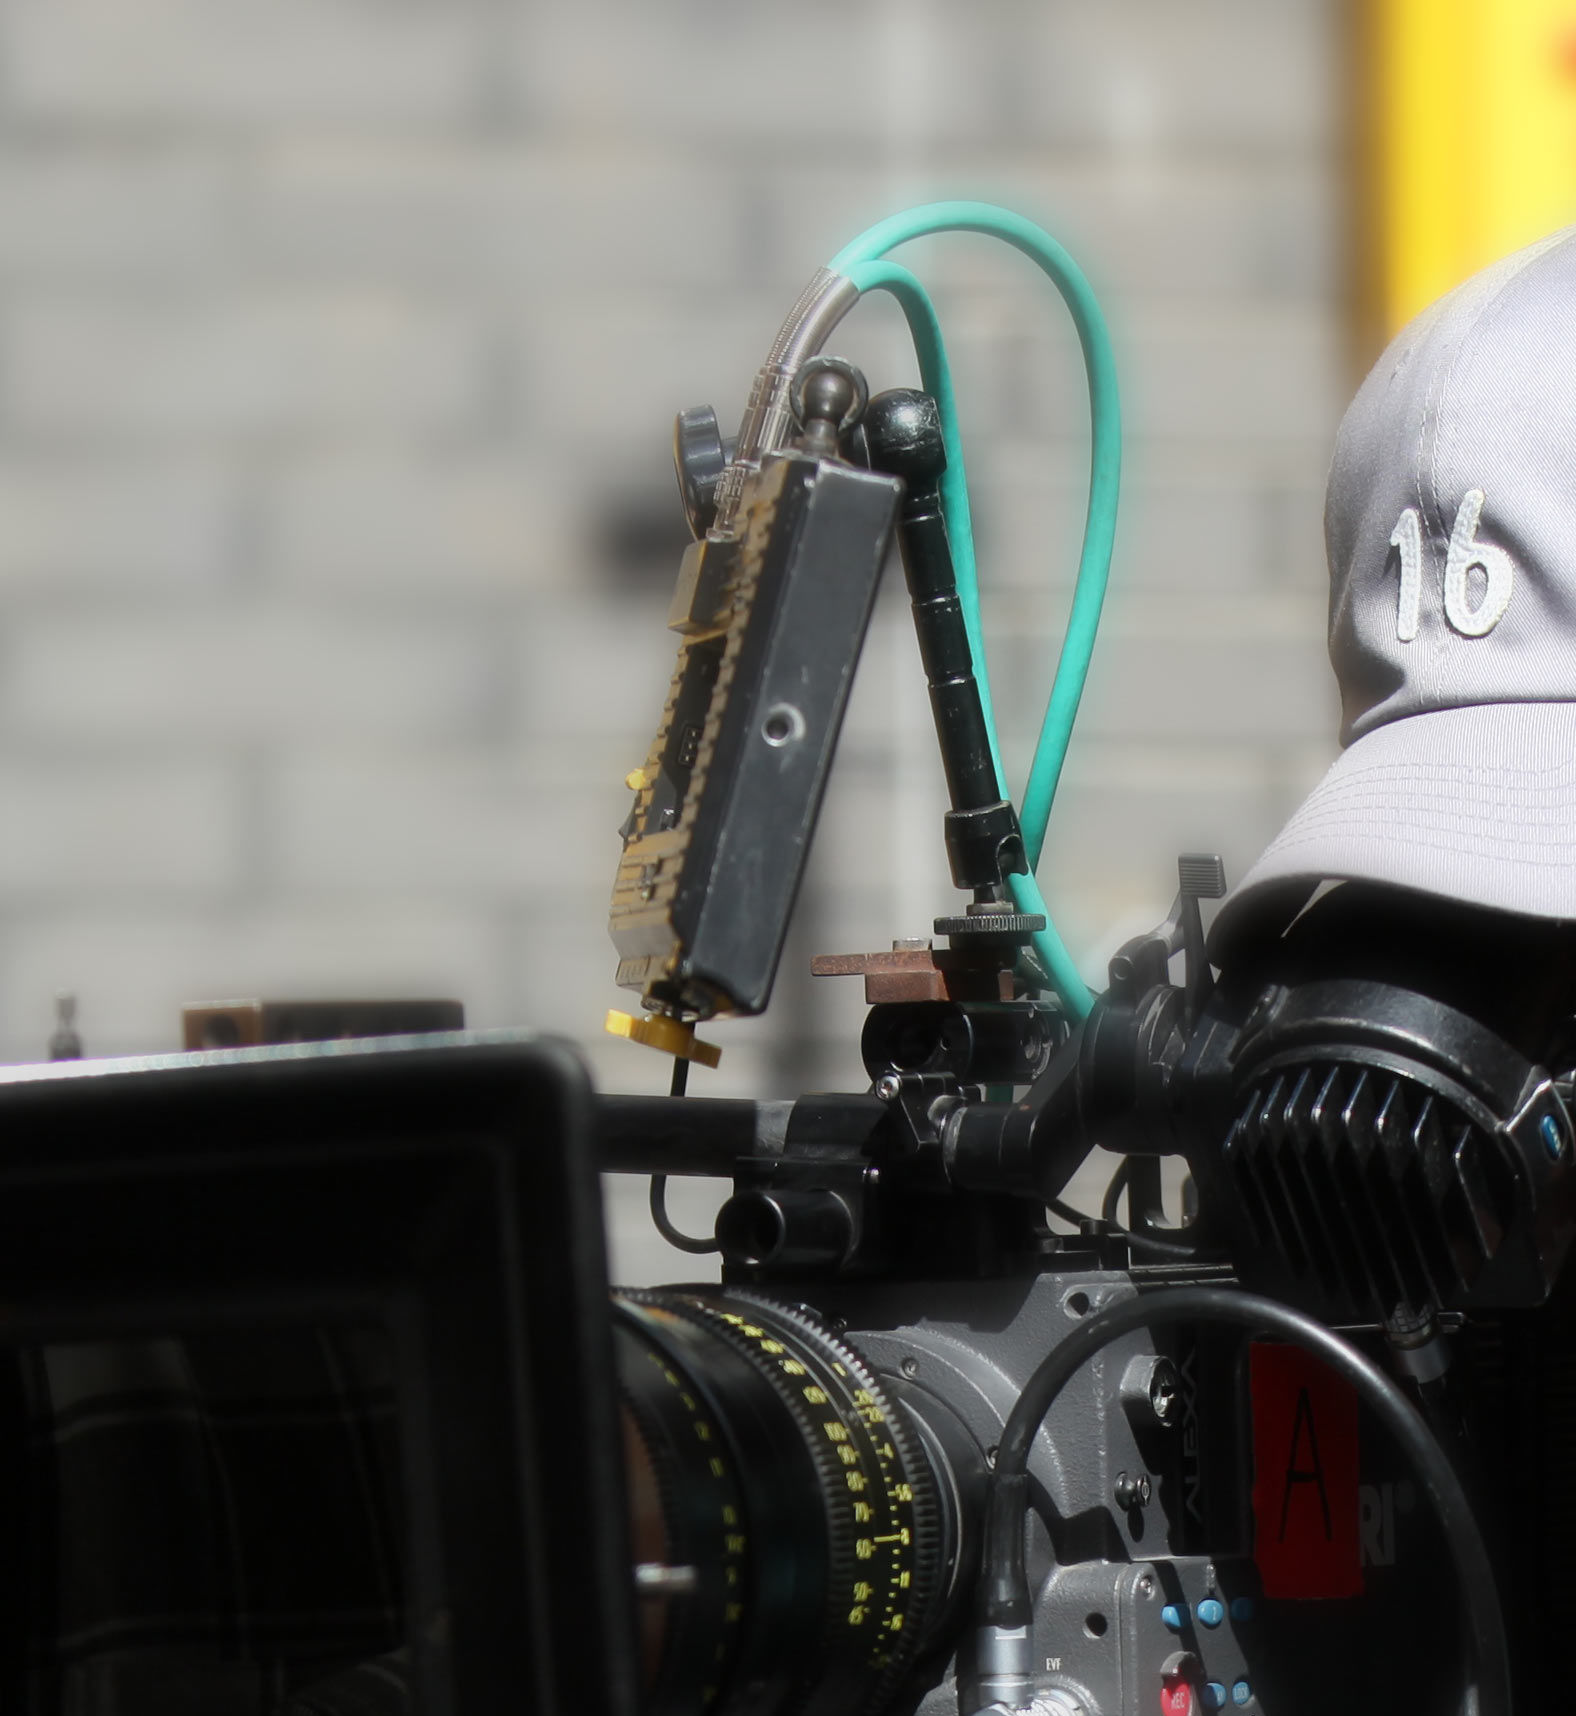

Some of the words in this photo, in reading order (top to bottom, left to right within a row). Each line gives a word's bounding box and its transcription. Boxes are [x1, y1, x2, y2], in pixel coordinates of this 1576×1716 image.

[1389, 490, 1514, 642] 16
[1279, 1386, 1335, 1544] A
[1046, 1657, 1062, 1671] EVF
